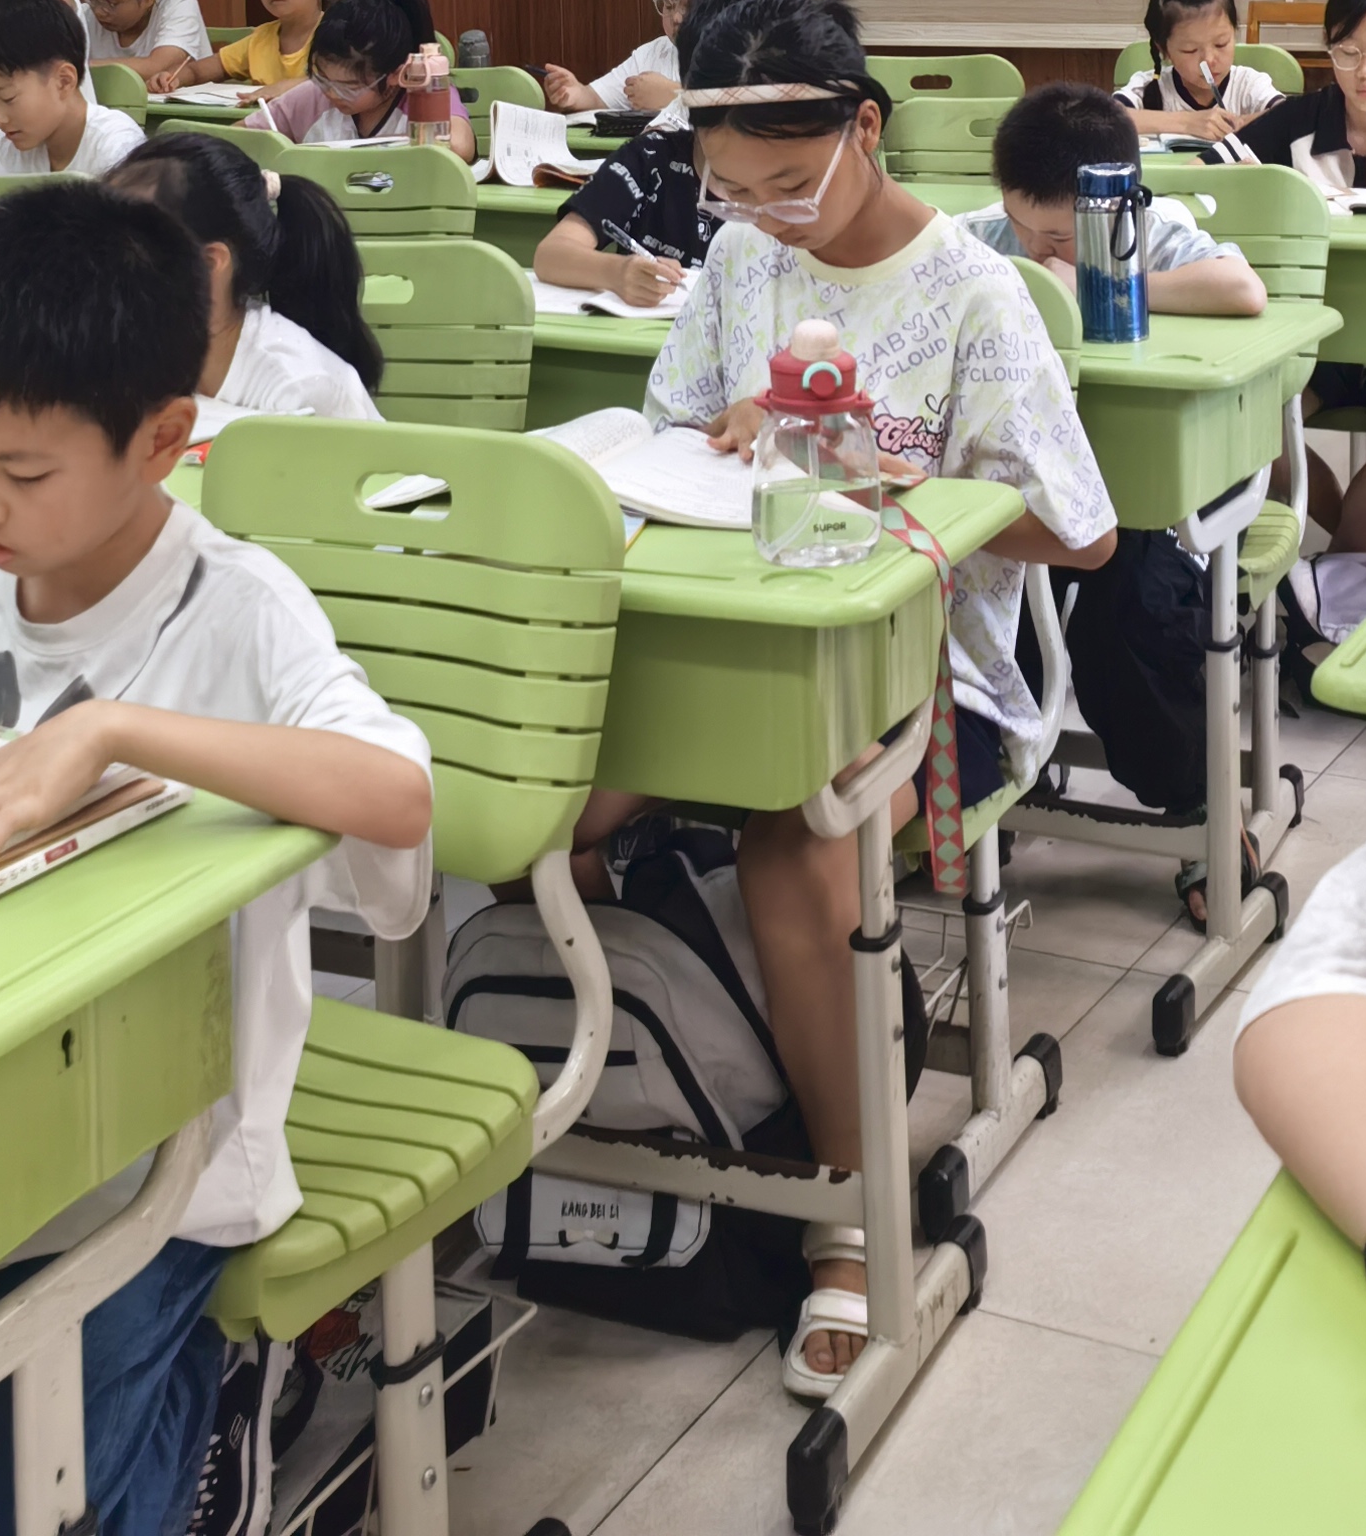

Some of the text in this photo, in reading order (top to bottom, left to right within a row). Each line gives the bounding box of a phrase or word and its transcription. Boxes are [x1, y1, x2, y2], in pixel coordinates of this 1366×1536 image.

[609, 161, 645, 200] SEVEN
[642, 235, 686, 260] SEVEN
[944, 263, 1009, 287] CLOUD
[885, 336, 948, 380] CLOUD
[969, 366, 1031, 383] CLOUD
[813, 521, 847, 533] SUPOR
[561, 1200, 588, 1217] KANG
[590, 1202, 606, 1219] BEI
